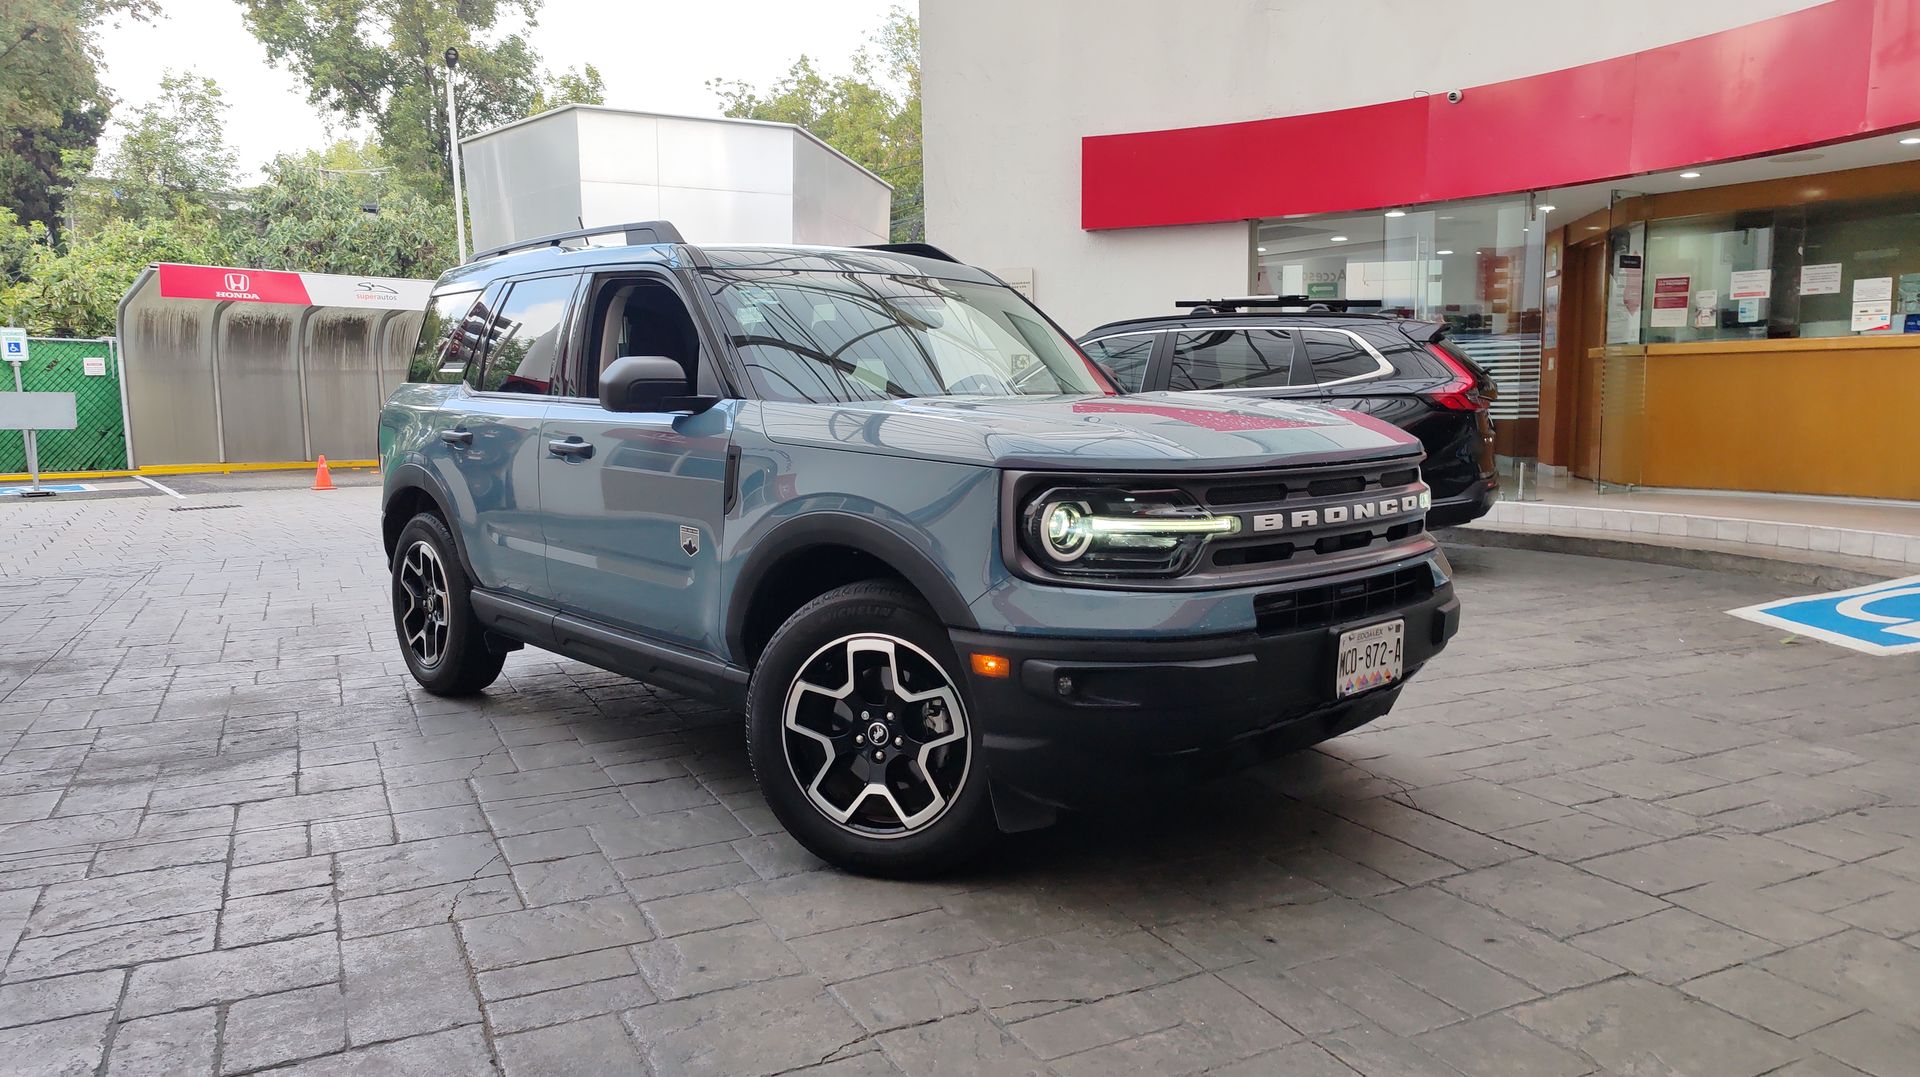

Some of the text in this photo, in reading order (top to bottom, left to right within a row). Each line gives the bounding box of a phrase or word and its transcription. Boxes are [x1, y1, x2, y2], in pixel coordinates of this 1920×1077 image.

[216, 291, 260, 300] HONDA
[356, 292, 397, 301] superautos
[1253, 495, 1418, 532] BRONCO
[1339, 637, 1401, 679] MCD-872-A
